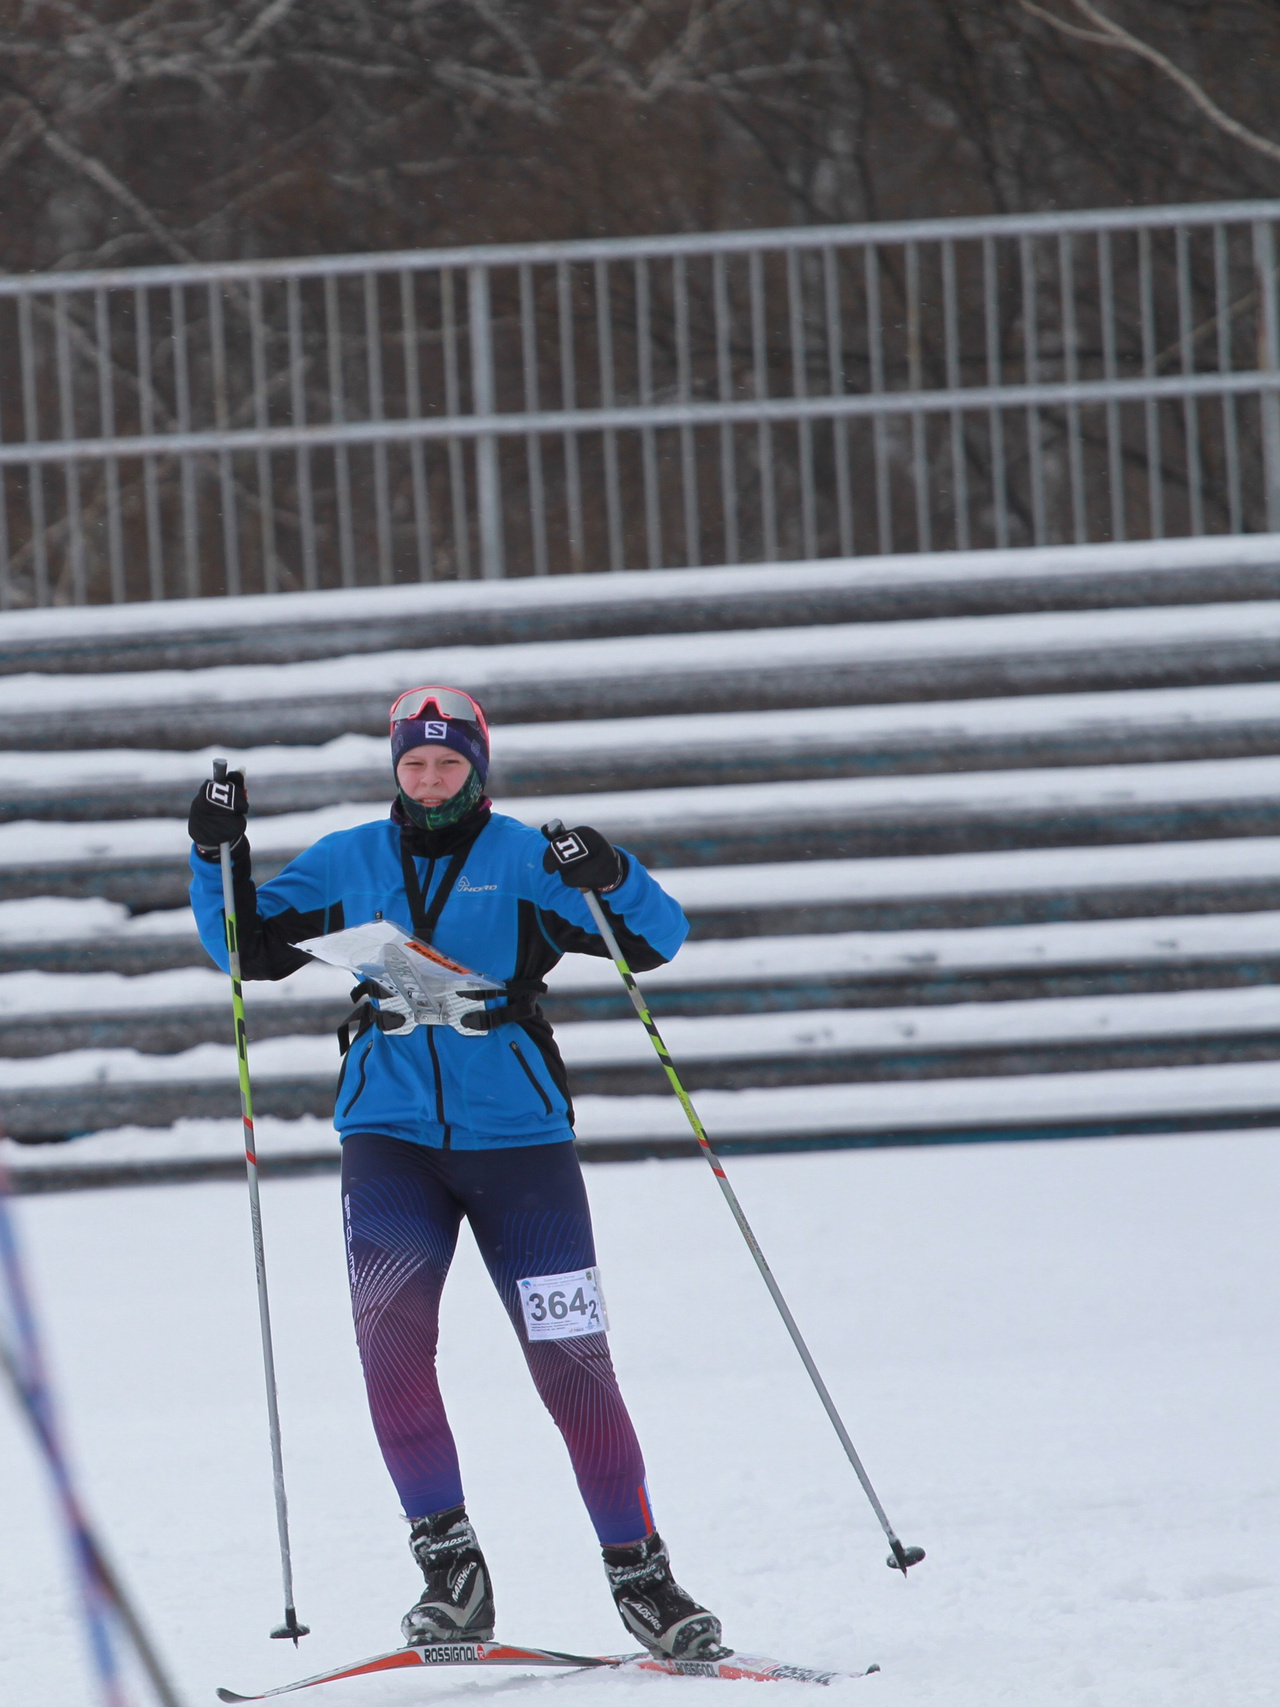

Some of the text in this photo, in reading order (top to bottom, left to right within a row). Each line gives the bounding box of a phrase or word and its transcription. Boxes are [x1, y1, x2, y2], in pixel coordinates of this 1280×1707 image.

[427, 722, 445, 737] S
[463, 884, 498, 893] NORD
[528, 1286, 588, 1322] 364
[424, 1646, 477, 1663] ROSSIGNOL
